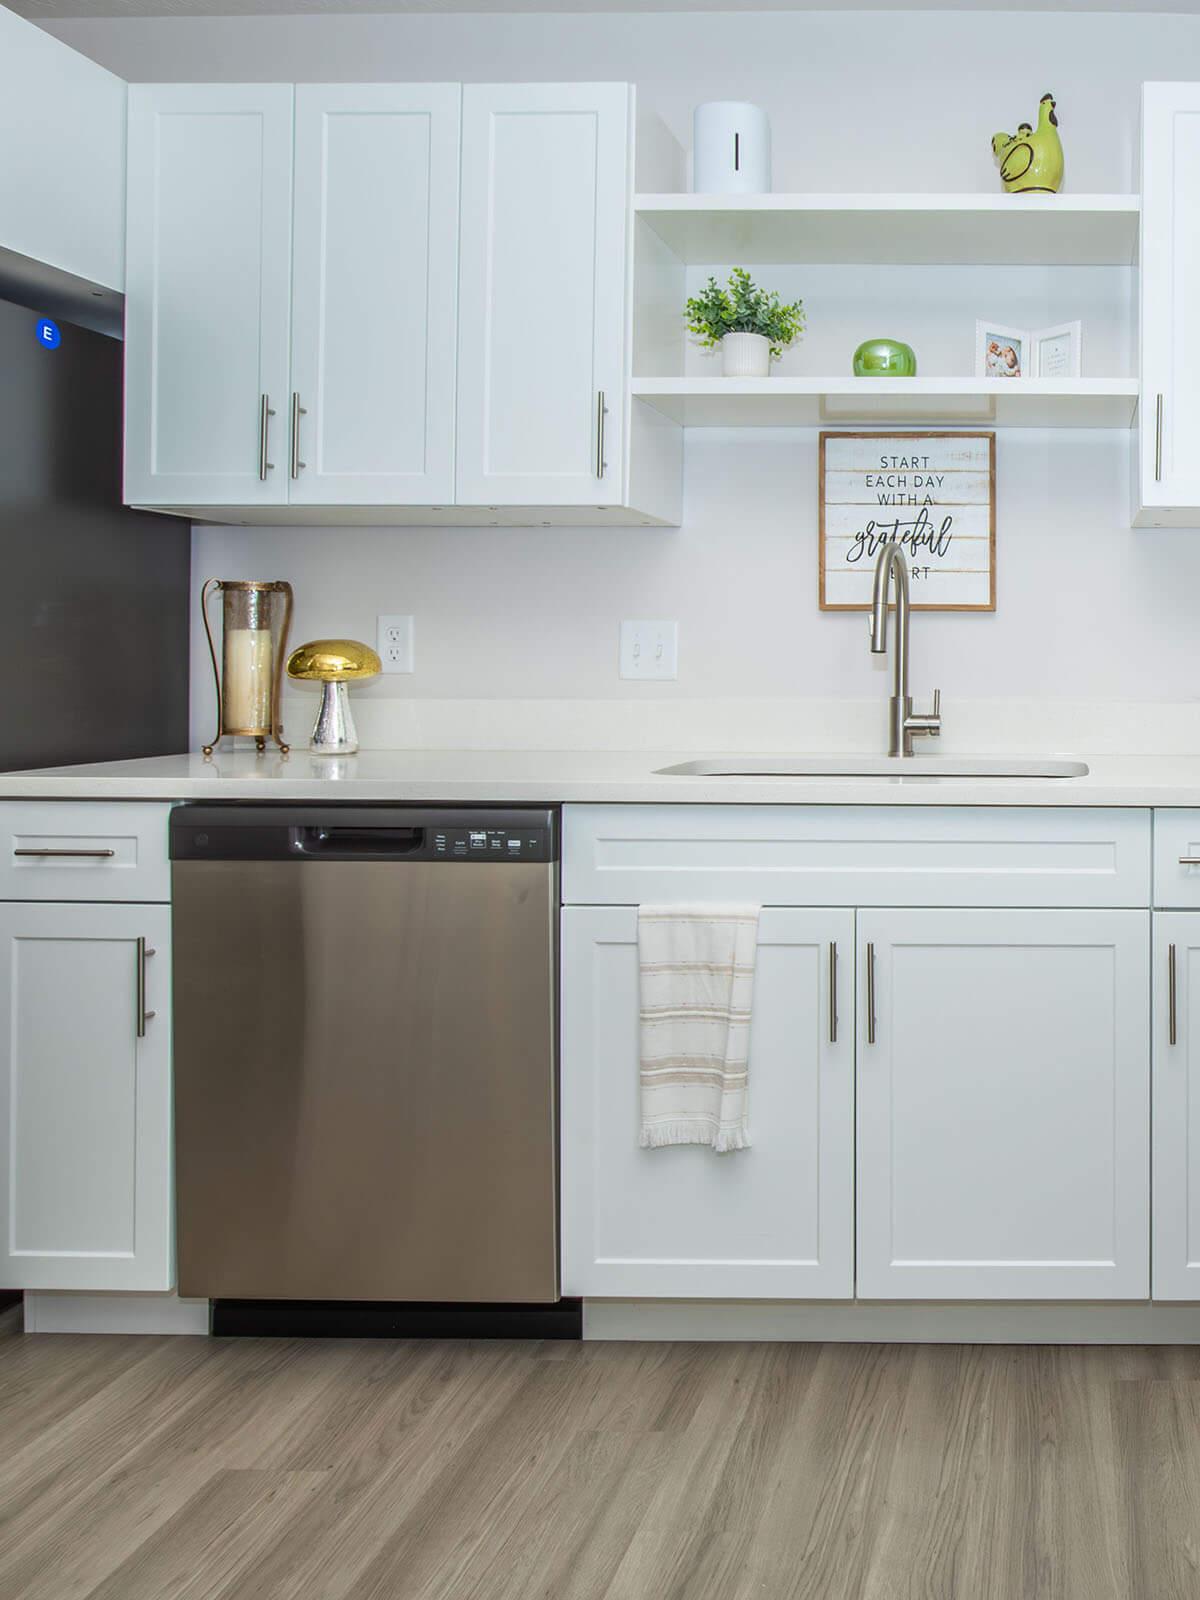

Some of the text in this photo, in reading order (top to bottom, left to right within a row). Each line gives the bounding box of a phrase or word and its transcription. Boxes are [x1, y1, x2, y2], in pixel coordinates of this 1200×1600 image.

[43, 325, 53, 341] E
[880, 456, 930, 469] START
[865, 475, 945, 488] EACH DAY
[877, 493, 934, 506] WITH A
[846, 507, 953, 562] grateful
